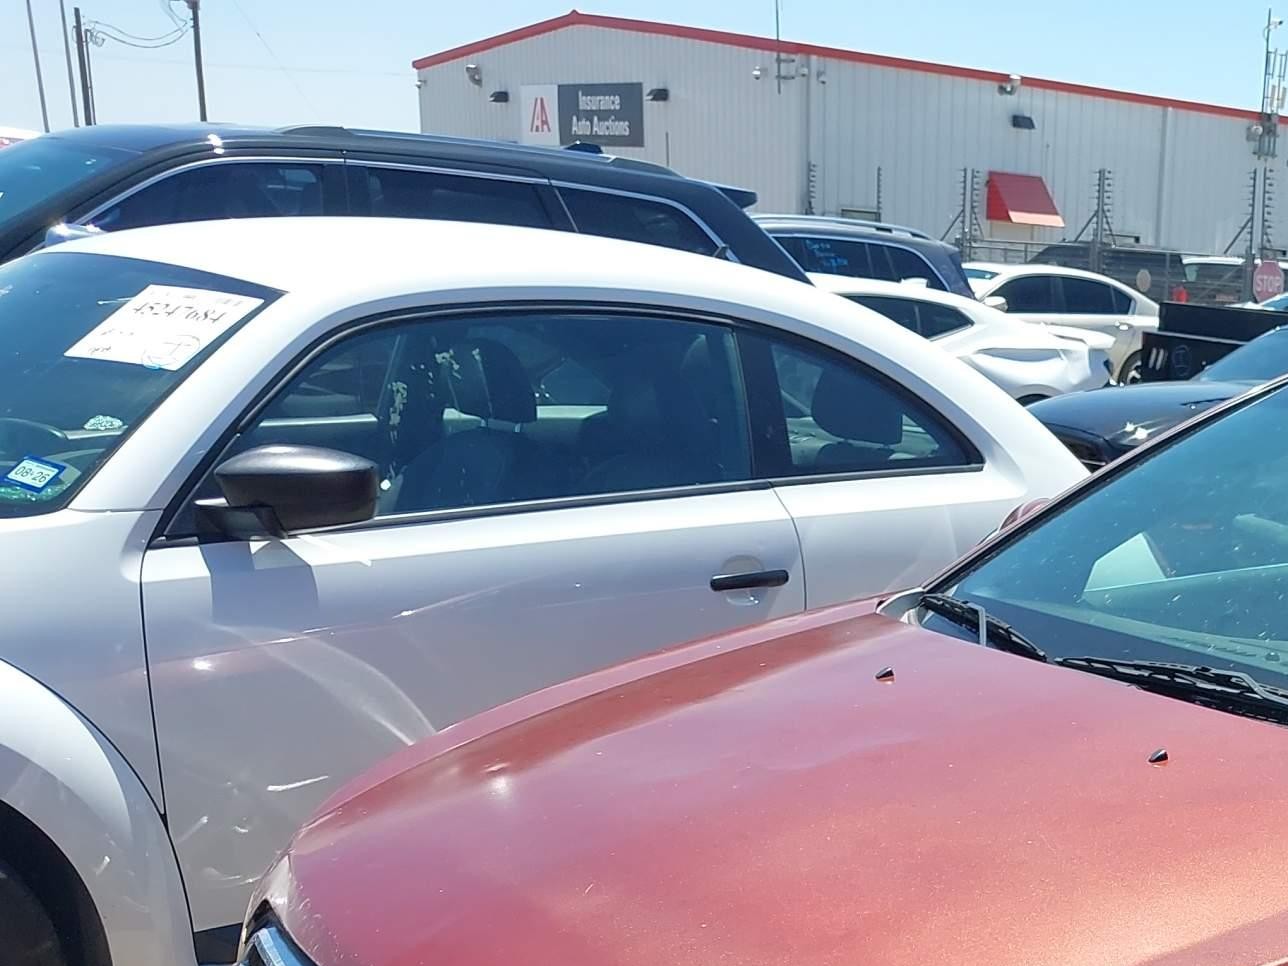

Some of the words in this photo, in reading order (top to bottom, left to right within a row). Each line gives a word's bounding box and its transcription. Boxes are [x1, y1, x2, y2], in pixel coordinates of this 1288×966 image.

[578, 90, 621, 111] Insurance
[571, 115, 591, 136] Auto
[592, 115, 630, 136] Auctions
[1256, 275, 1281, 292] STOP
